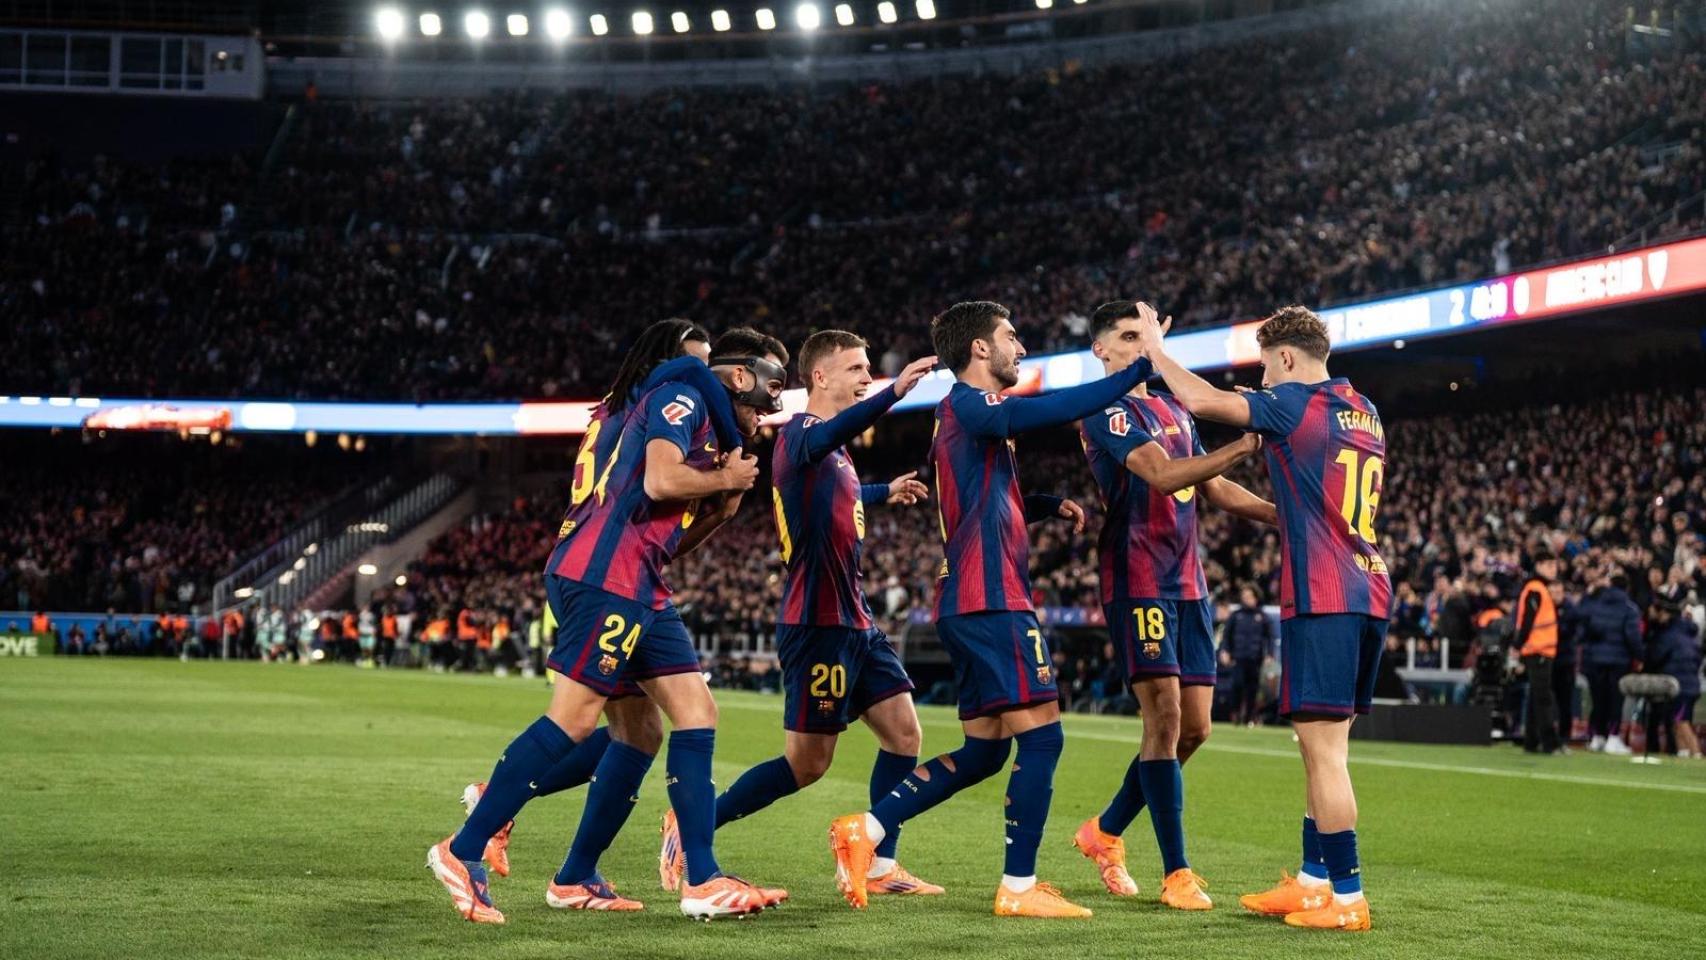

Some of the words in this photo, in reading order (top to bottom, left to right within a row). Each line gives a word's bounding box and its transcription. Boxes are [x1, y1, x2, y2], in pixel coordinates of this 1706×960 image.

[1449, 288, 1465, 326] 2
[1513, 276, 1530, 316] 0
[1335, 410, 1385, 443] FERMÍN
[1335, 448, 1385, 544] 16
[599, 613, 642, 661] 24
[1132, 607, 1166, 641] 18
[1027, 629, 1044, 664] 7
[810, 663, 846, 698] 20
